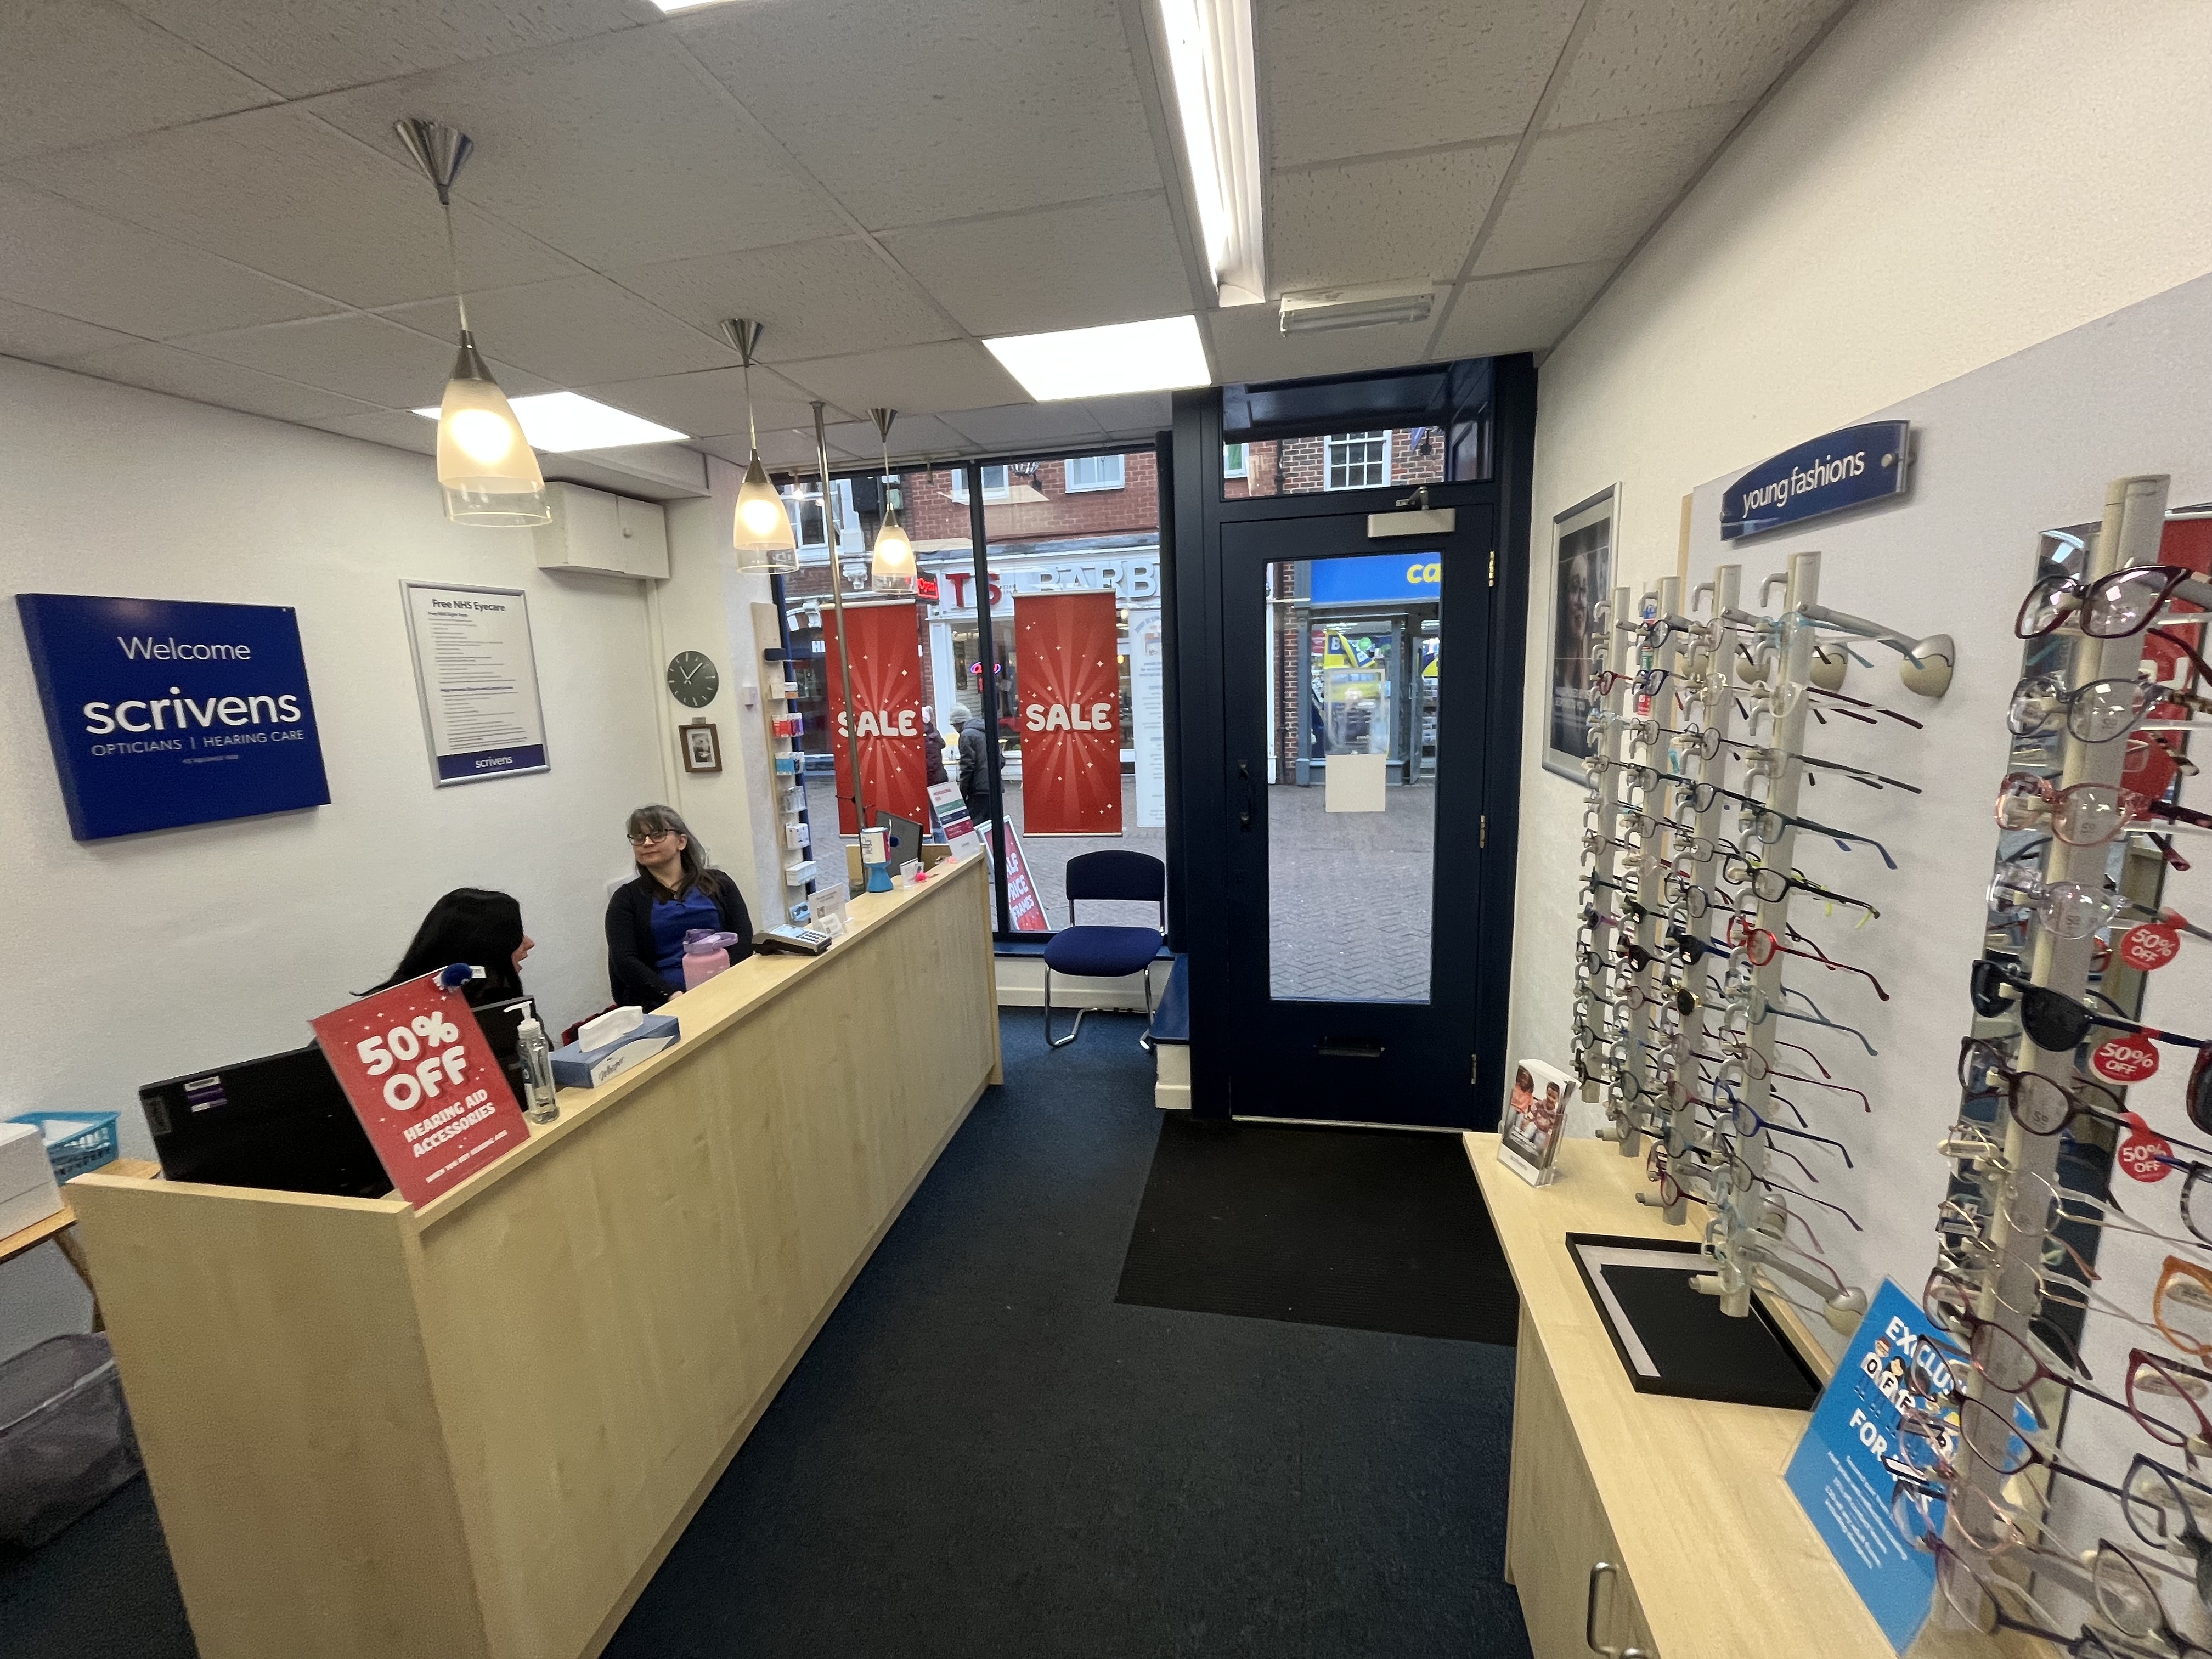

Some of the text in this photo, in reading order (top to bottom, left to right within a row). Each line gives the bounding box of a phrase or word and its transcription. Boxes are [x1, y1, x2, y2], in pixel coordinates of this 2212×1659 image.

[1742, 450, 1865, 519] young fashions
[431, 599, 506, 612] Free NHS Eyecare
[117, 636, 252, 661] Welcome
[83, 686, 302, 735] scrivens
[837, 709, 917, 737] SALE
[1026, 703, 1112, 732] SALE
[91, 730, 306, 757] OPTICIANS HEARING CARE
[475, 755, 513, 769] scrivens
[2131, 928, 2176, 956] 50%
[2131, 945, 2159, 962] OFF
[356, 1011, 460, 1076] 50%
[2099, 1042, 2154, 1068] 50%
[382, 1045, 467, 1111] OFF
[2105, 1060, 2138, 1074] OFF
[403, 1088, 488, 1143] HEARING AID
[412, 1102, 496, 1158] ACCESSORIES
[2123, 1143, 2167, 1162] 50%
[2134, 1160, 2160, 1173] OFF
[1849, 1407, 1888, 1463] FOR
